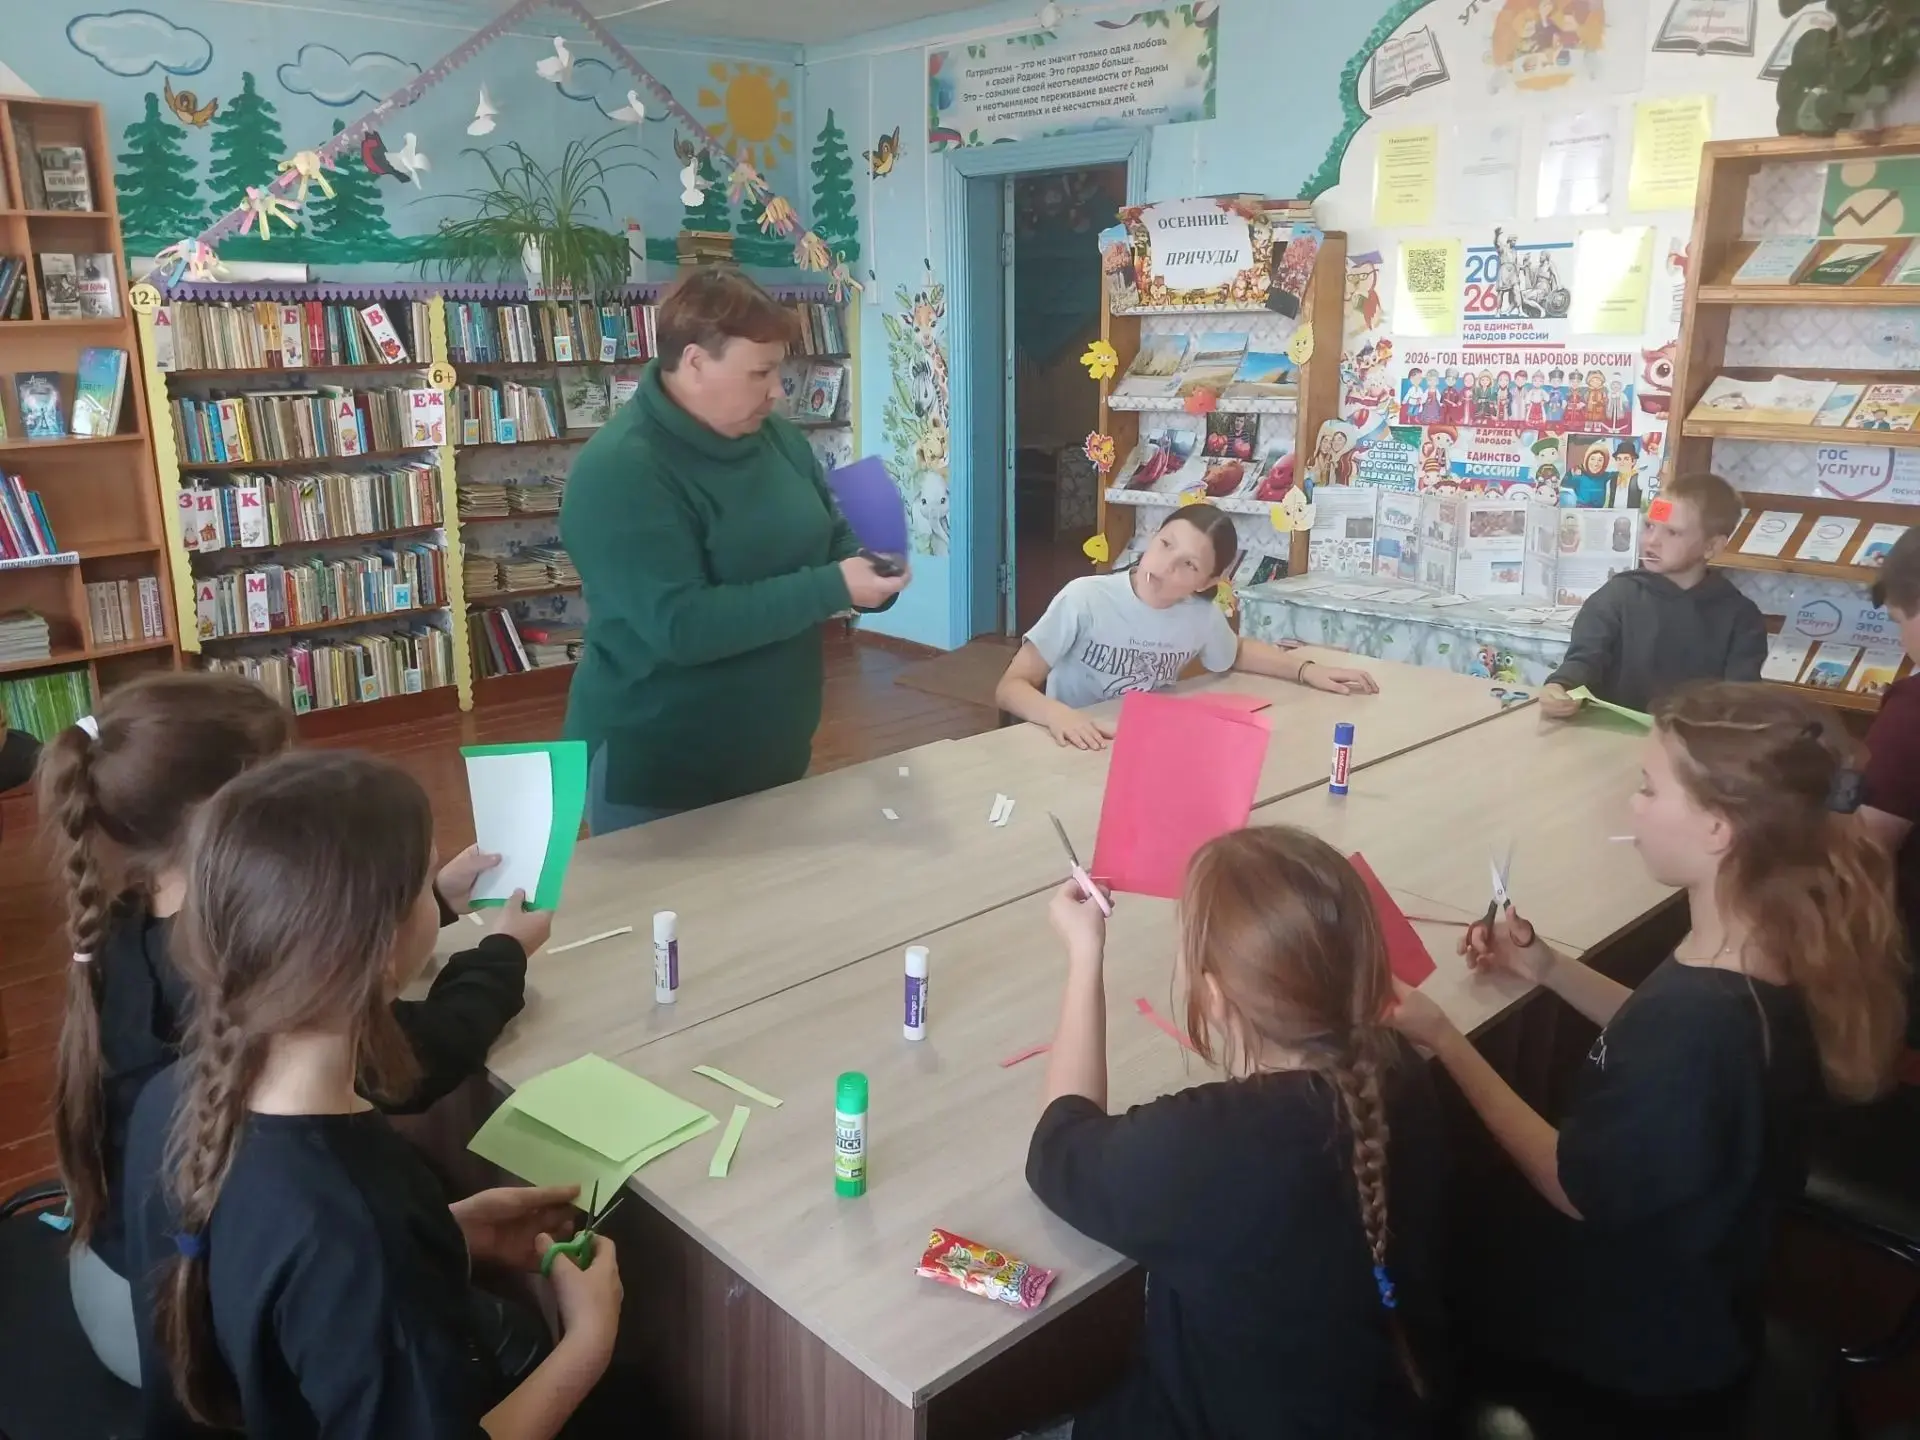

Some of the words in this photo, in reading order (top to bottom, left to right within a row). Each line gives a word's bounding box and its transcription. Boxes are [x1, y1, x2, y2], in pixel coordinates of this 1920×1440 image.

[965, 65, 1013, 79] Патриотизм
[1021, 61, 1035, 70] это
[1037, 59, 1047, 67] не
[1048, 53, 1076, 65] значит
[1078, 48, 1108, 60] только
[1110, 44, 1131, 55] одна
[1133, 37, 1168, 50] любовь
[992, 75, 1015, 86] своей
[1049, 66, 1065, 77] Это
[1067, 63, 1100, 76] гораздо
[962, 93, 977, 103] Это
[985, 87, 1021, 100] сознание
[1022, 82, 1045, 93] своей
[1047, 71, 1120, 89] неотъемлемости
[1121, 71, 1132, 79] от
[1134, 63, 1169, 76] Родины
[976, 105, 982, 113] и
[983, 96, 1039, 111] неотъемлемое
[1040, 88, 1097, 104] переживание
[1099, 83, 1128, 95] вместе
[1137, 77, 1154, 88] ней
[998, 107, 1042, 121] счастливых
[1063, 99, 1111, 112] несчастных
[1158, 213, 1229, 230] ОСЕННИЕ
[1165, 249, 1239, 266] ПРИЧУДЫ
[1465, 254, 1500, 283] 20
[131, 291, 160, 305] 12+
[1464, 284, 1498, 312] 26
[155, 310, 172, 326] А
[284, 309, 297, 325] Б
[367, 310, 384, 326] В
[1462, 323, 1481, 332] ГОД
[1484, 323, 1534, 331] ЕДИНСТВА
[1462, 332, 1507, 341] НАРОДОВ
[1509, 332, 1549, 340] РОССИИ
[1462, 353, 1520, 366] ЕДИНСТВА
[1525, 353, 1578, 366] НАРОДОВ
[1583, 353, 1632, 367] РОССИИ
[433, 369, 454, 383] 6+
[221, 404, 233, 420] Г
[339, 402, 354, 418] Д
[1467, 451, 1521, 463] ЕДИНСТВО
[1818, 449, 1849, 461] гос
[1465, 463, 1521, 478] РОССИИ!
[1817, 462, 1881, 478] услуги
[179, 493, 193, 508] З
[197, 496, 213, 511] И
[241, 493, 260, 507] К
[248, 578, 266, 593] М
[199, 586, 214, 602] Л
[1081, 640, 1140, 676] HEART
[837, 1127, 861, 1139] LUE
